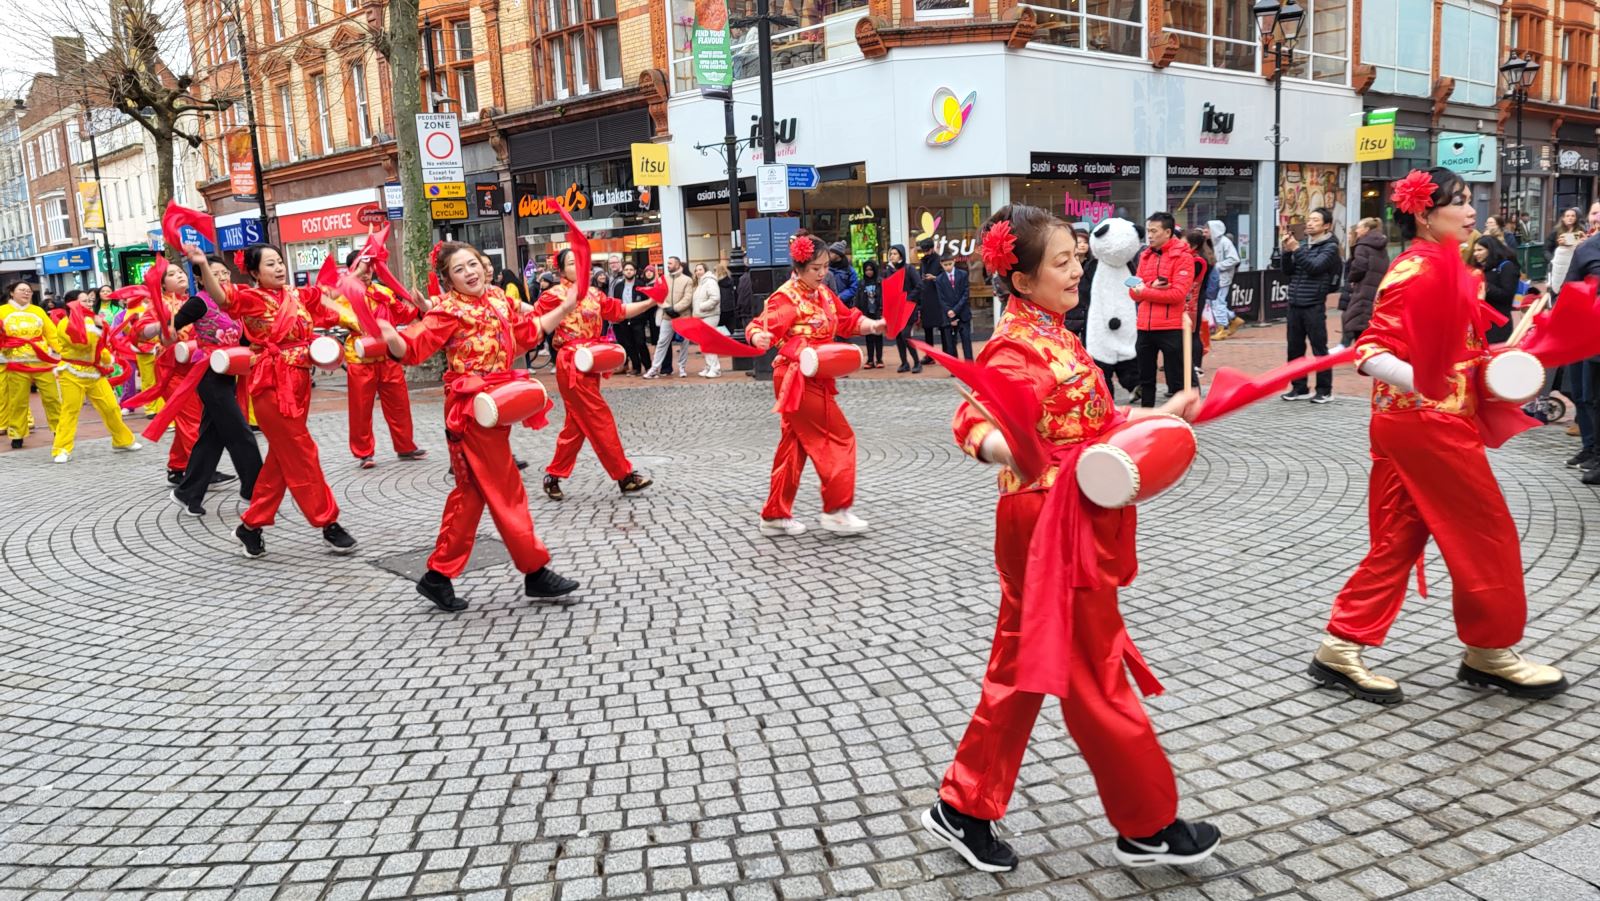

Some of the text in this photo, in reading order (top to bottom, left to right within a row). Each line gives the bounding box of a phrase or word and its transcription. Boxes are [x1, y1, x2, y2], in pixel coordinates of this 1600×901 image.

[695, 29, 709, 37] FIND
[698, 37, 724, 45] FLAVOUR
[424, 121, 451, 129] ZONE
[1201, 101, 1235, 134] itsu
[1359, 137, 1387, 151] itsu
[751, 151, 763, 161] eat
[1441, 157, 1474, 166] KOKORO
[640, 156, 666, 173] itsu
[1031, 160, 1051, 173] sushi
[1057, 163, 1078, 175] soups
[1084, 162, 1096, 173] rice
[1097, 162, 1116, 174] bowls
[1167, 165, 1177, 175] hot
[1177, 165, 1200, 175] noodles
[1203, 166, 1217, 175] asian
[1218, 165, 1235, 176] salads
[518, 182, 633, 218] Wenel's the bakers
[697, 186, 742, 201] asian salas
[435, 209, 465, 217] CYCLING
[443, 202, 455, 210] NO
[1065, 191, 1115, 224] hungry
[301, 212, 352, 233] POST OFFICE
[933, 233, 976, 256] itsu
[1231, 283, 1254, 307] itsu
[1271, 280, 1289, 302] its
